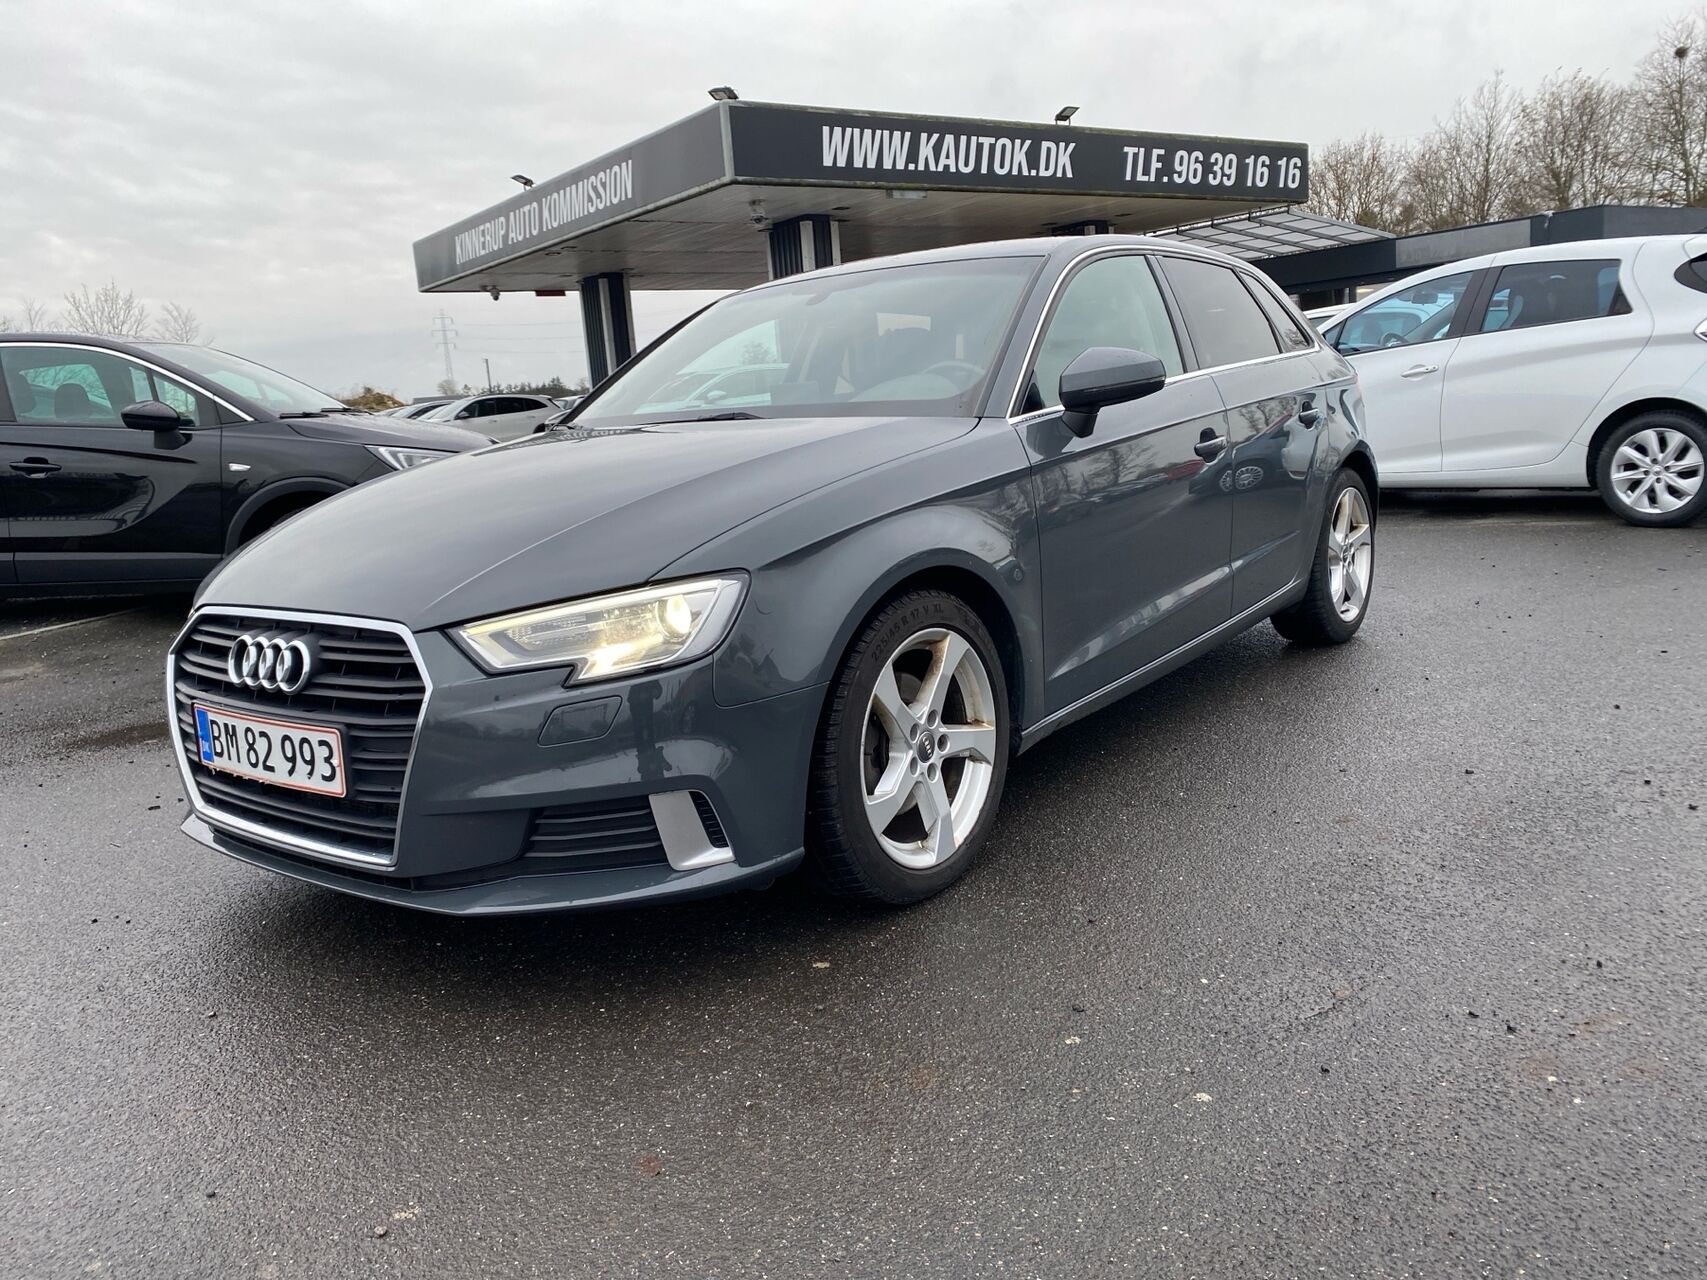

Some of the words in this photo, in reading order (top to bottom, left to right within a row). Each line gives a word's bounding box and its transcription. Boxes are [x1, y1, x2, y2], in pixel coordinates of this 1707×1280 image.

[822, 125, 1076, 178] WWW.KAUTOK.DK
[1123, 146, 1168, 183] TLF.
[1173, 150, 1204, 185] 96
[1208, 152, 1238, 187] 39
[1245, 155, 1271, 188] 16
[1277, 157, 1302, 190] 16
[455, 216, 506, 265] KINNERUP
[508, 202, 539, 245] AUTO
[542, 160, 633, 232] KOMMISSION
[210, 719, 241, 764] BM
[244, 726, 276, 773] 82
[281, 734, 337, 783] 993
